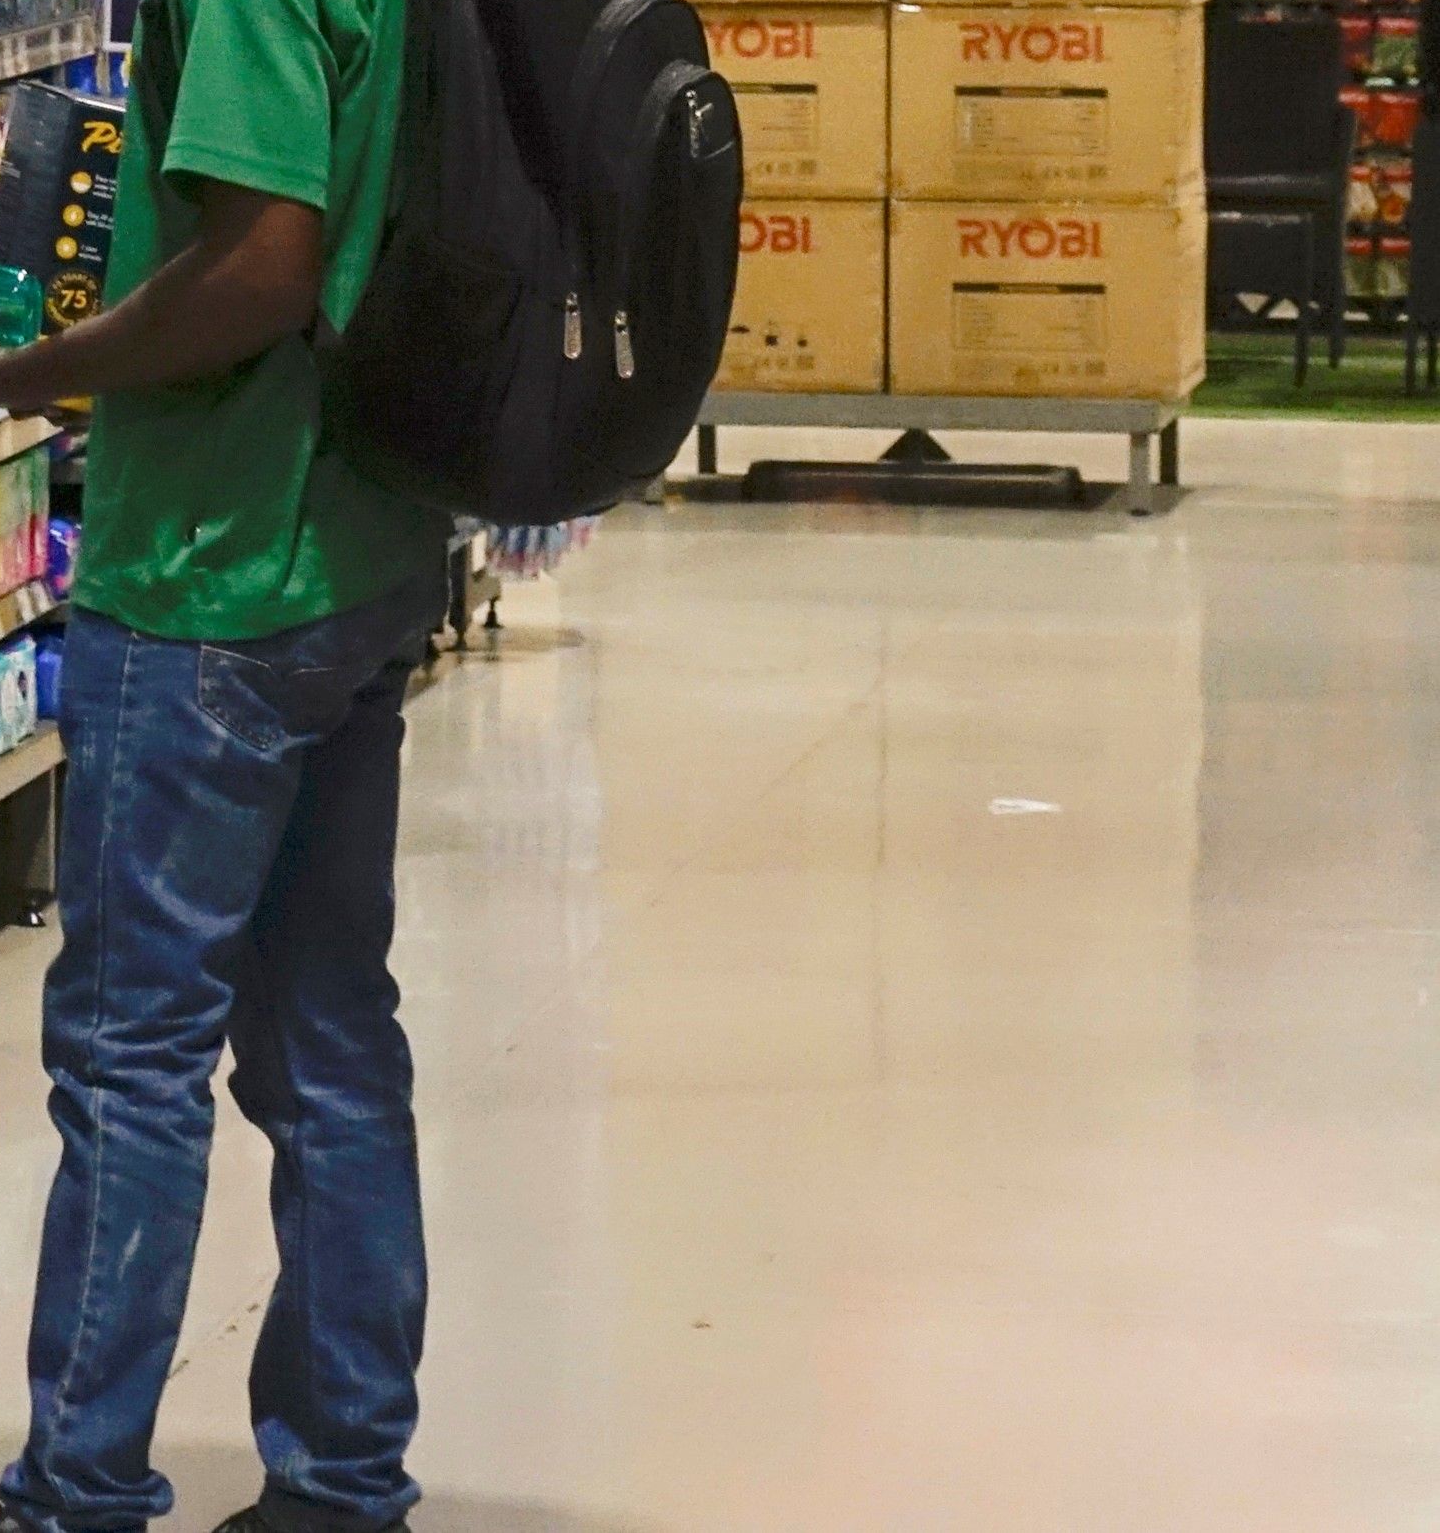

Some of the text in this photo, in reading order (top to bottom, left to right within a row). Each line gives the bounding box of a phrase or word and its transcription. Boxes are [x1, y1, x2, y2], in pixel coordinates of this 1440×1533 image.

[958, 21, 1103, 64] RYOBI
[956, 219, 1102, 258] RYOBI
[61, 290, 87, 308] 75
